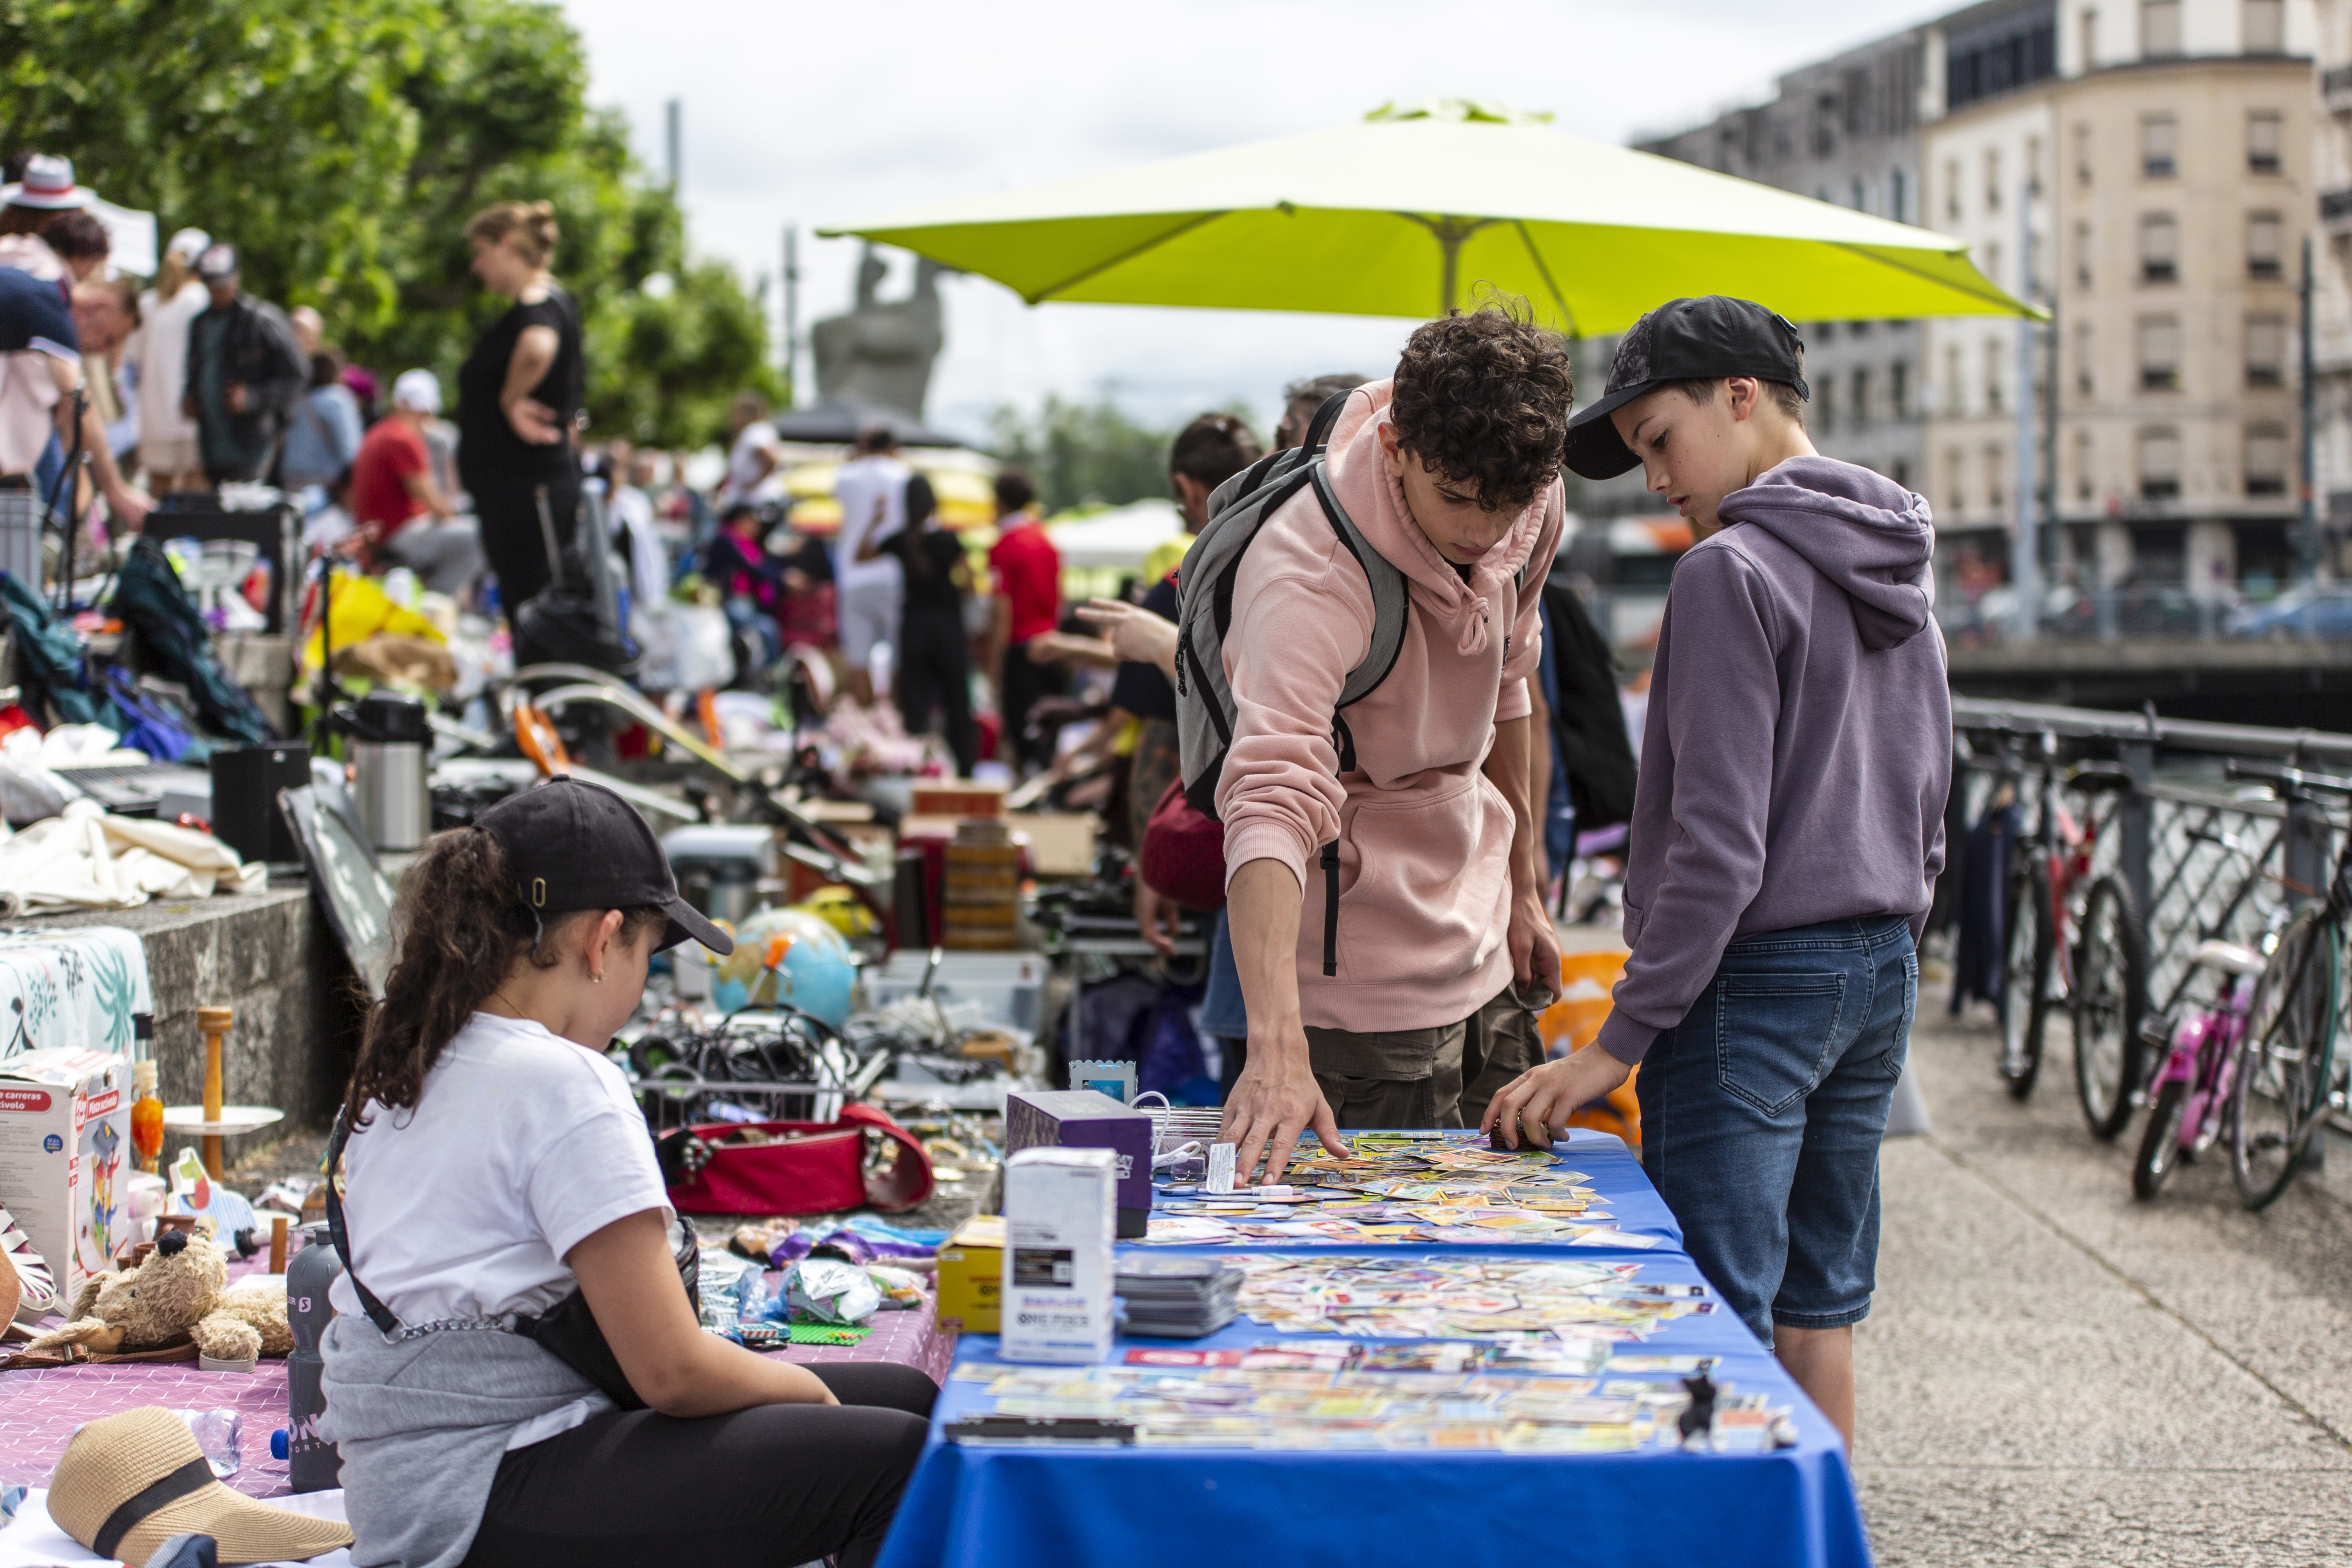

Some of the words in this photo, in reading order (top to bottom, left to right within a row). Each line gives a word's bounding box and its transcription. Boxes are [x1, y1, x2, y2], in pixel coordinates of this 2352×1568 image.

[5, 1092, 41, 1100] carreras
[0, 1101, 25, 1109] ivolo
[77, 1100, 87, 1116] Play
[89, 1101, 100, 1115] Pista
[100, 1094, 117, 1111] scivolo
[76, 1113, 86, 1127] tive
